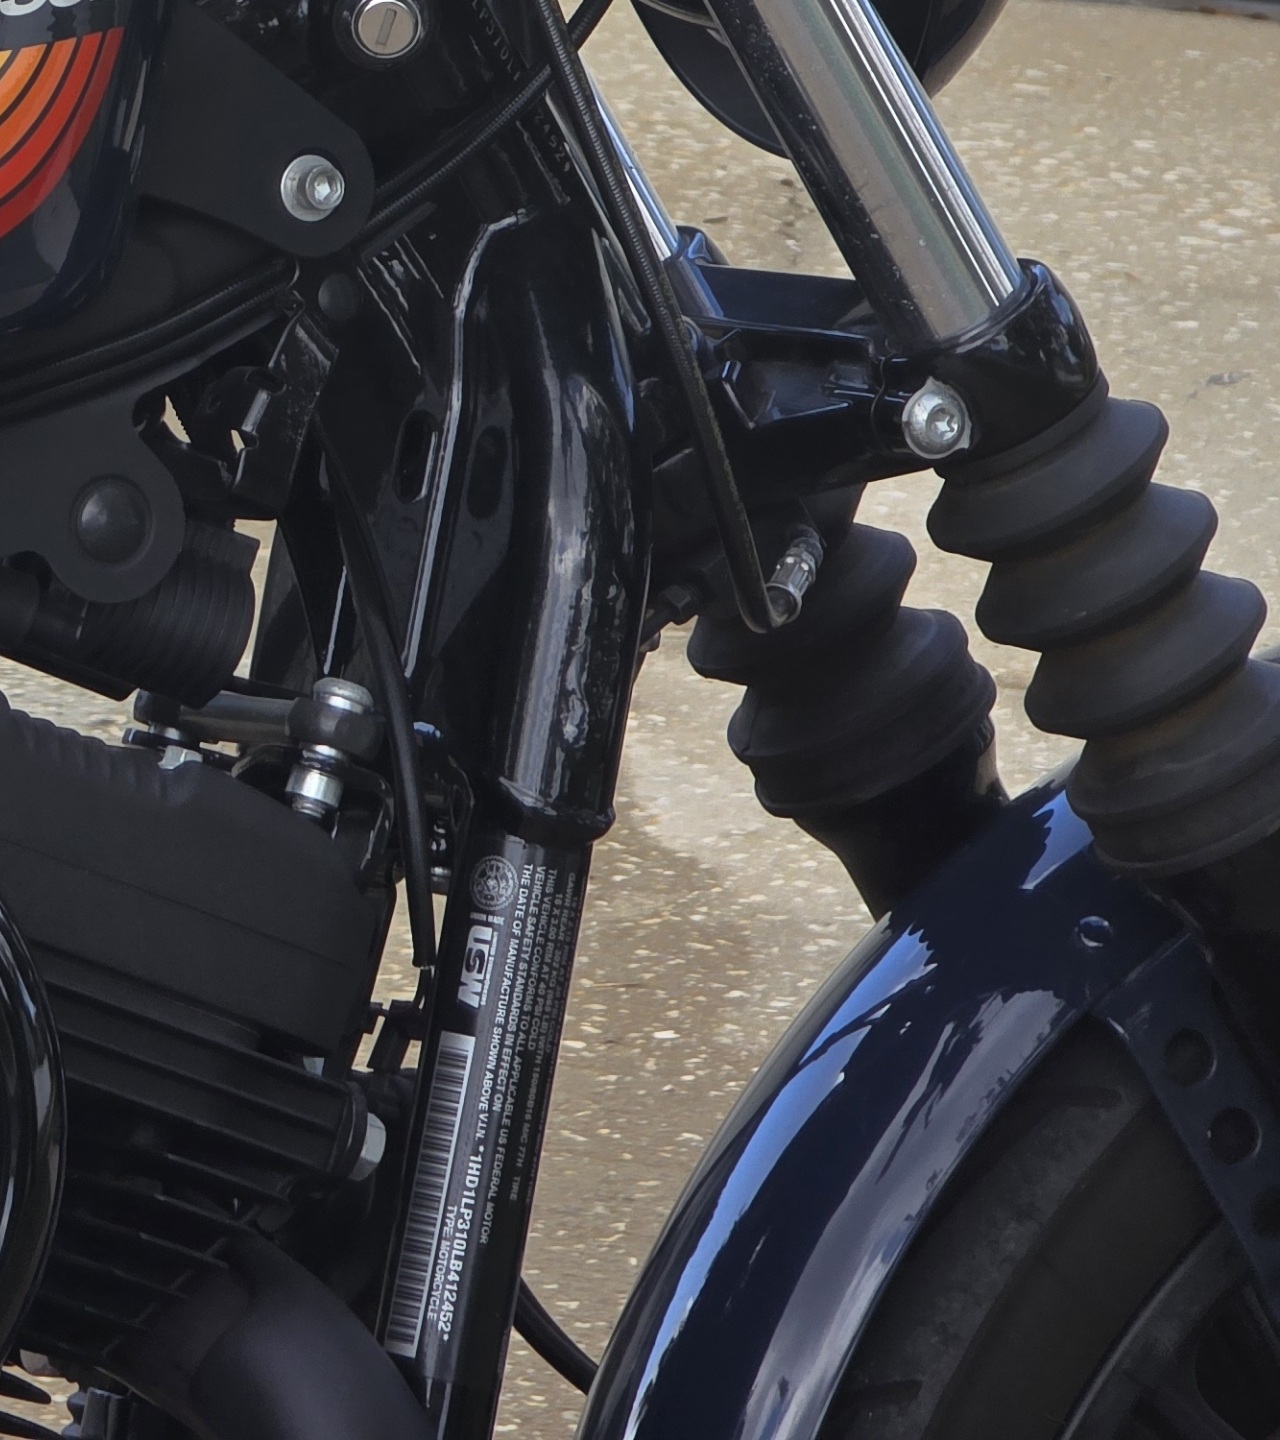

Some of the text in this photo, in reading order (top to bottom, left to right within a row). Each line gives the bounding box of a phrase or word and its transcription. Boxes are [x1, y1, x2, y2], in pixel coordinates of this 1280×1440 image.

[548, 918, 558, 940] 3.00
[458, 925, 493, 1008] USW
[544, 942, 554, 963] RIM
[541, 964, 550, 981] AT
[478, 864, 533, 1111] THE DATE OF MANUFACTURE SHOWN ABOVE
[492, 867, 546, 1112] VEHICLE SAFETY STANDARDS IN EFFECT ON
[538, 981, 546, 995] 40
[534, 997, 544, 1016] PSI
[528, 1017, 540, 1050] COLD
[479, 870, 557, 1244] THIS VEHICLE CONFORMS TO ALL APPLICABLE US FEDERAL MOTOR
[510, 1176, 521, 1200] TIRE
[427, 1240, 451, 1322] MOTORCYCLE
